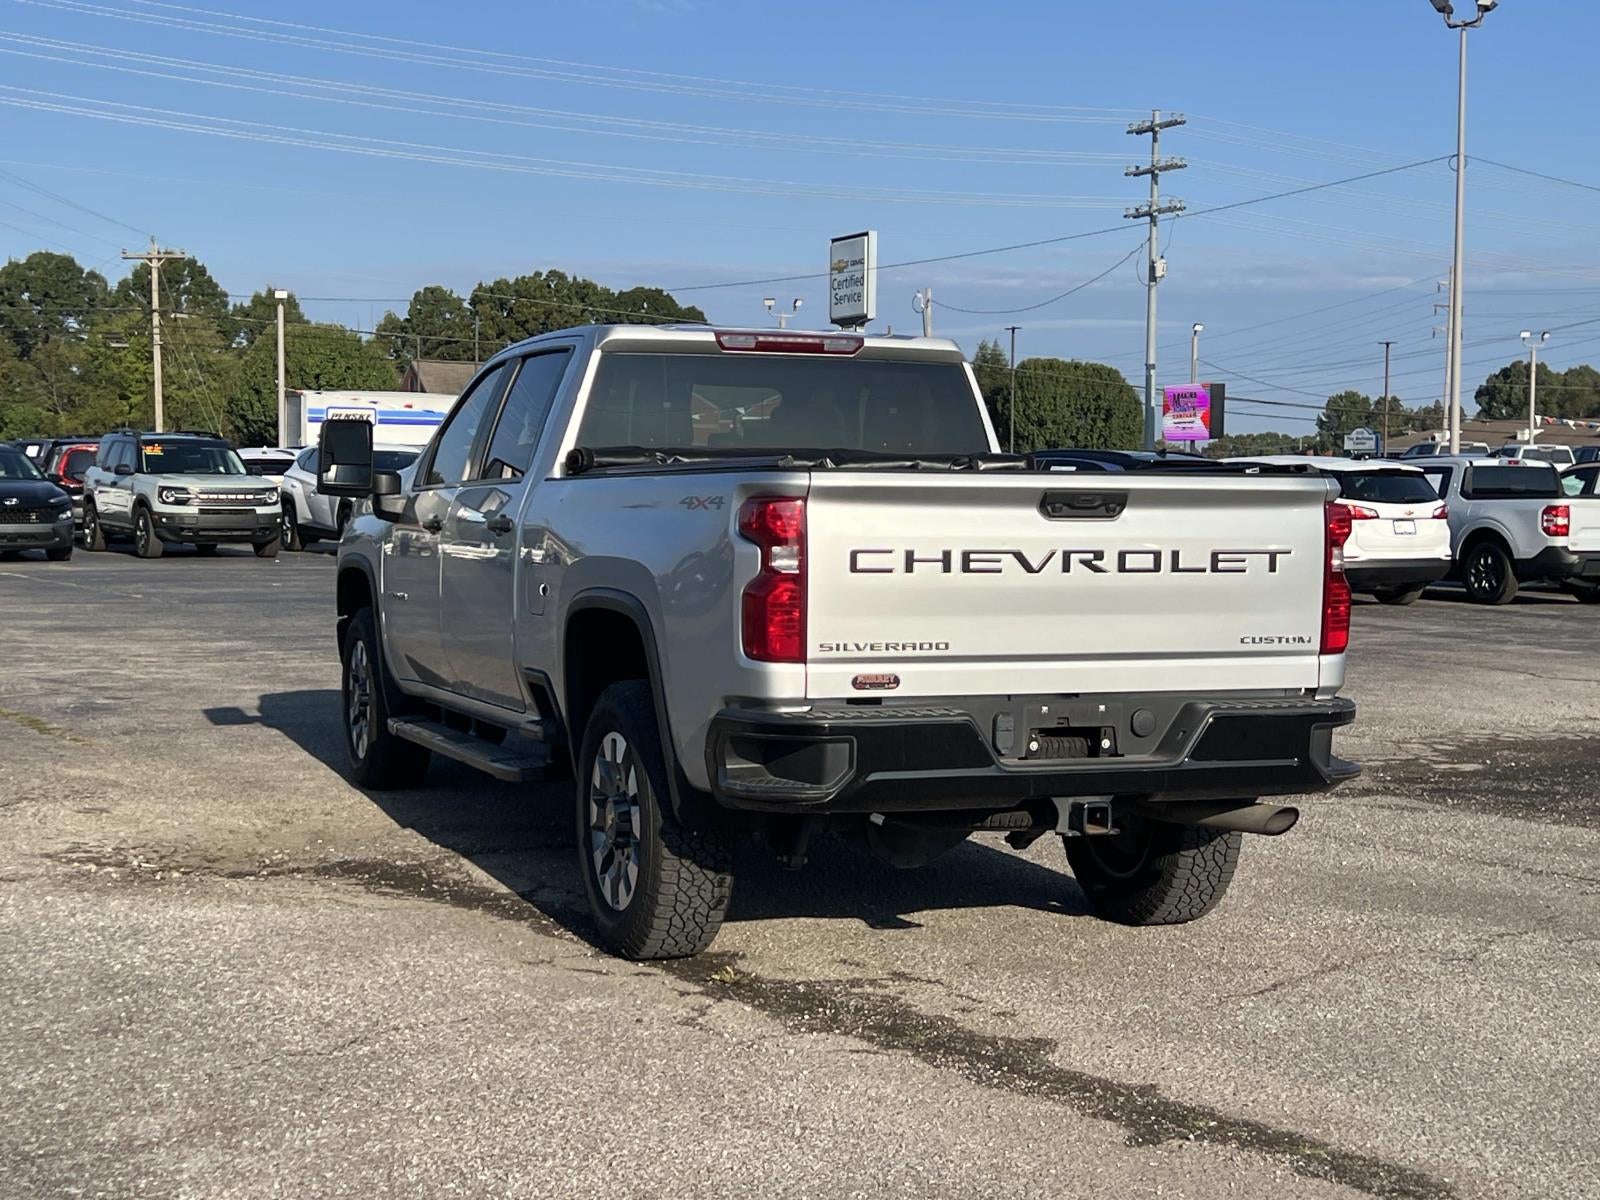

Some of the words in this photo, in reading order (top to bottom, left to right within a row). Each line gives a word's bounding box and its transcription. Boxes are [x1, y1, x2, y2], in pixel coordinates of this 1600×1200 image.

[832, 273, 864, 291] Certified
[834, 292, 862, 305] Service
[850, 549, 1292, 573] CHEVROLET
[1240, 636, 1311, 644] CUSTOM
[819, 642, 950, 652] SILVERADO
